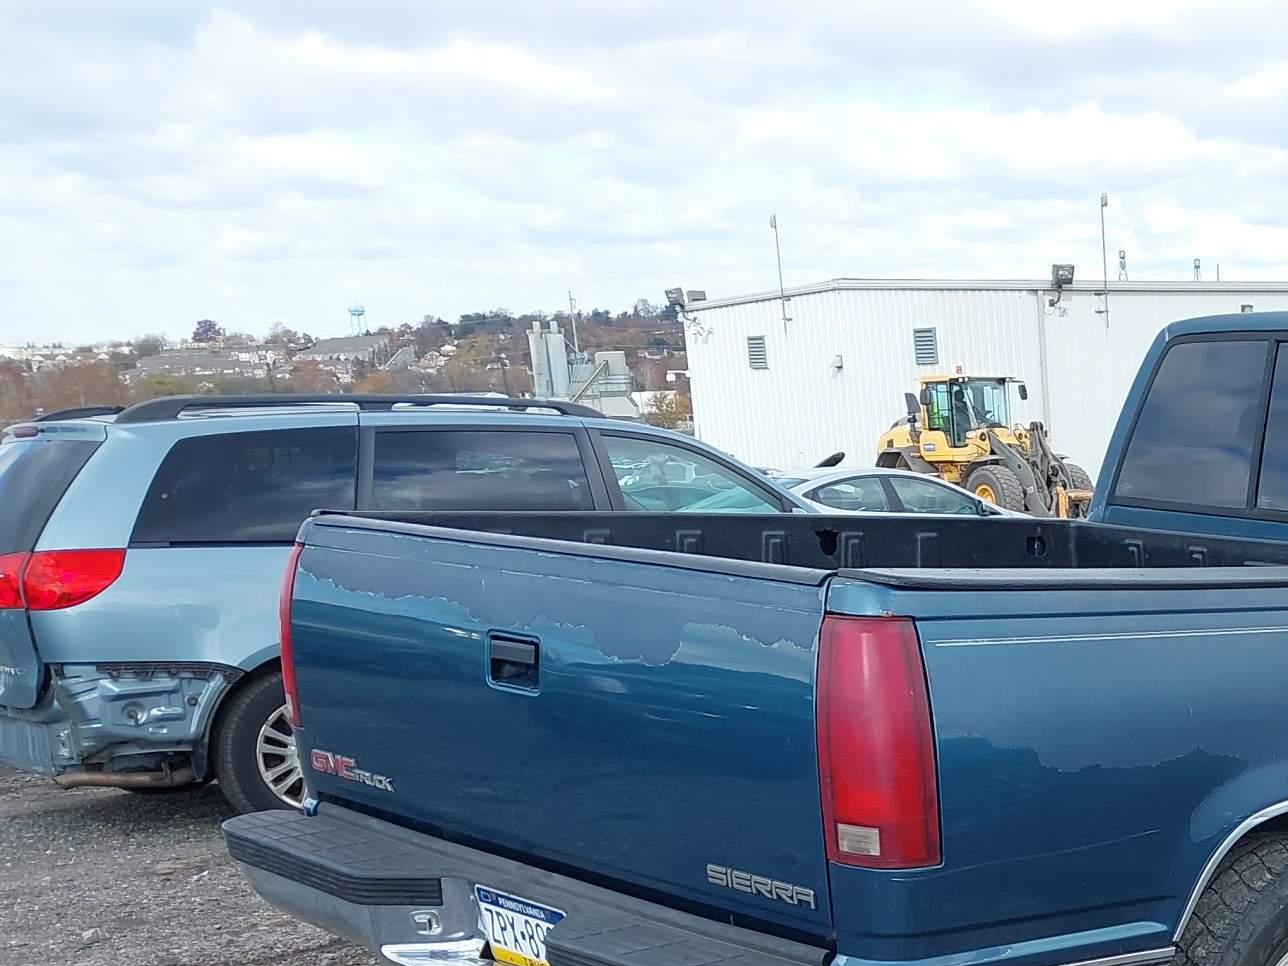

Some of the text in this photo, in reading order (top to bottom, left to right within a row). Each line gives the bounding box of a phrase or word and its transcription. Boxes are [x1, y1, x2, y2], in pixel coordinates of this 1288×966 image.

[311, 748, 395, 793] GMC TRUCK
[498, 897, 546, 920] PENNSYLVANIA
[706, 863, 816, 910] SIERRA
